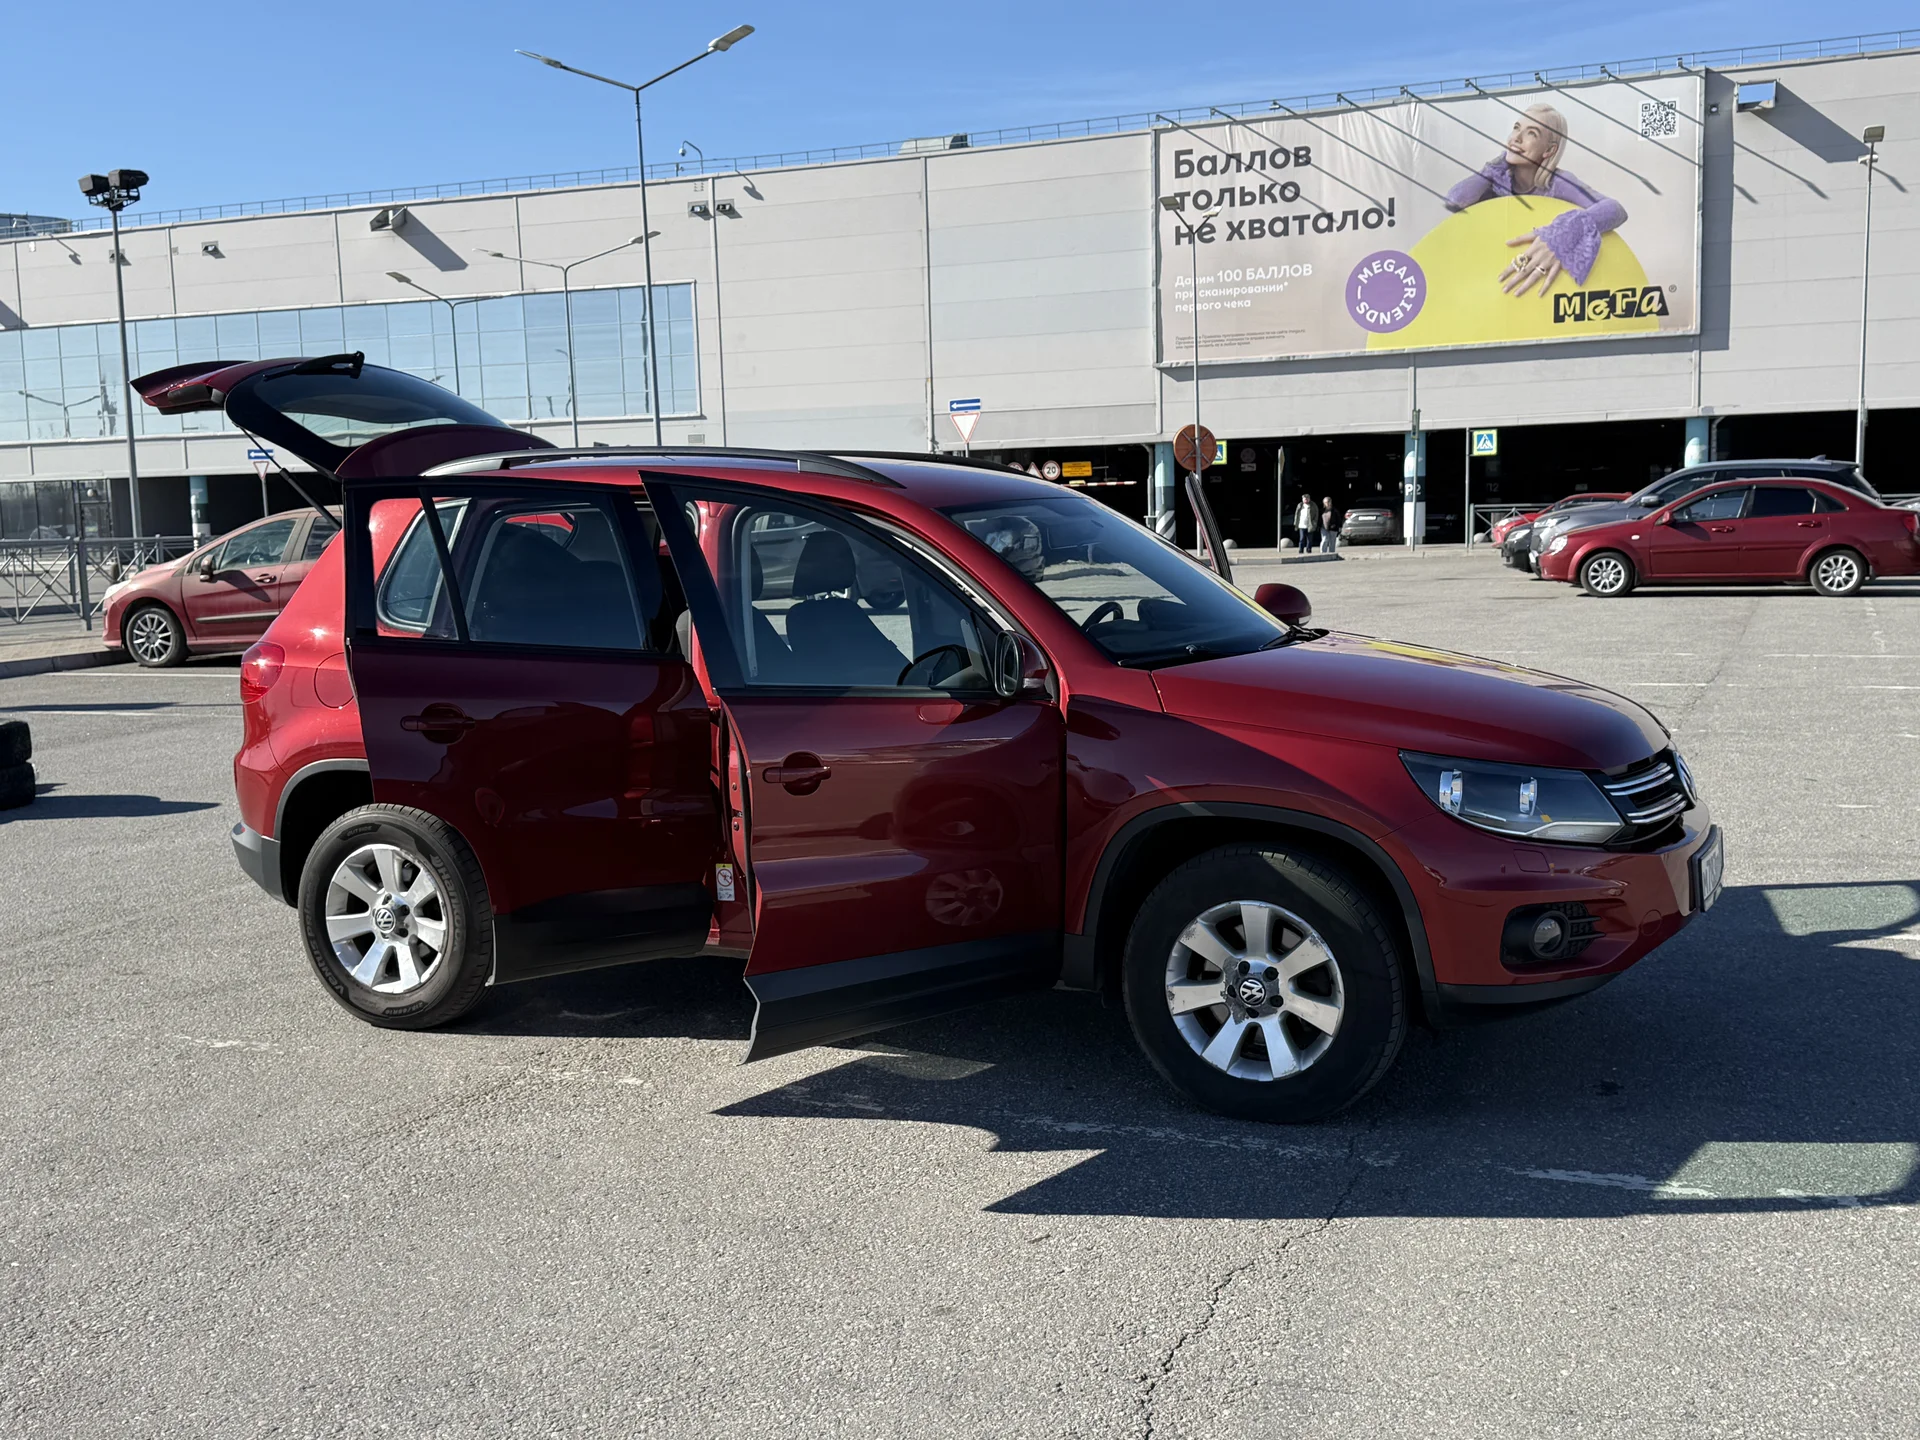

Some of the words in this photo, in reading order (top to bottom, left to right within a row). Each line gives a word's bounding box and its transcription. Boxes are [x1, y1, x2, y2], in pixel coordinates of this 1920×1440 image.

[1174, 146, 1312, 179] Баллов
[1174, 181, 1301, 212] только
[1175, 222, 1217, 246] не
[1226, 197, 1396, 242] хватало!
[1217, 269, 1242, 282] 100
[1246, 263, 1313, 280] БАЛЛОВ
[1224, 299, 1251, 308] чека
[1046, 466, 1057, 475] 20
